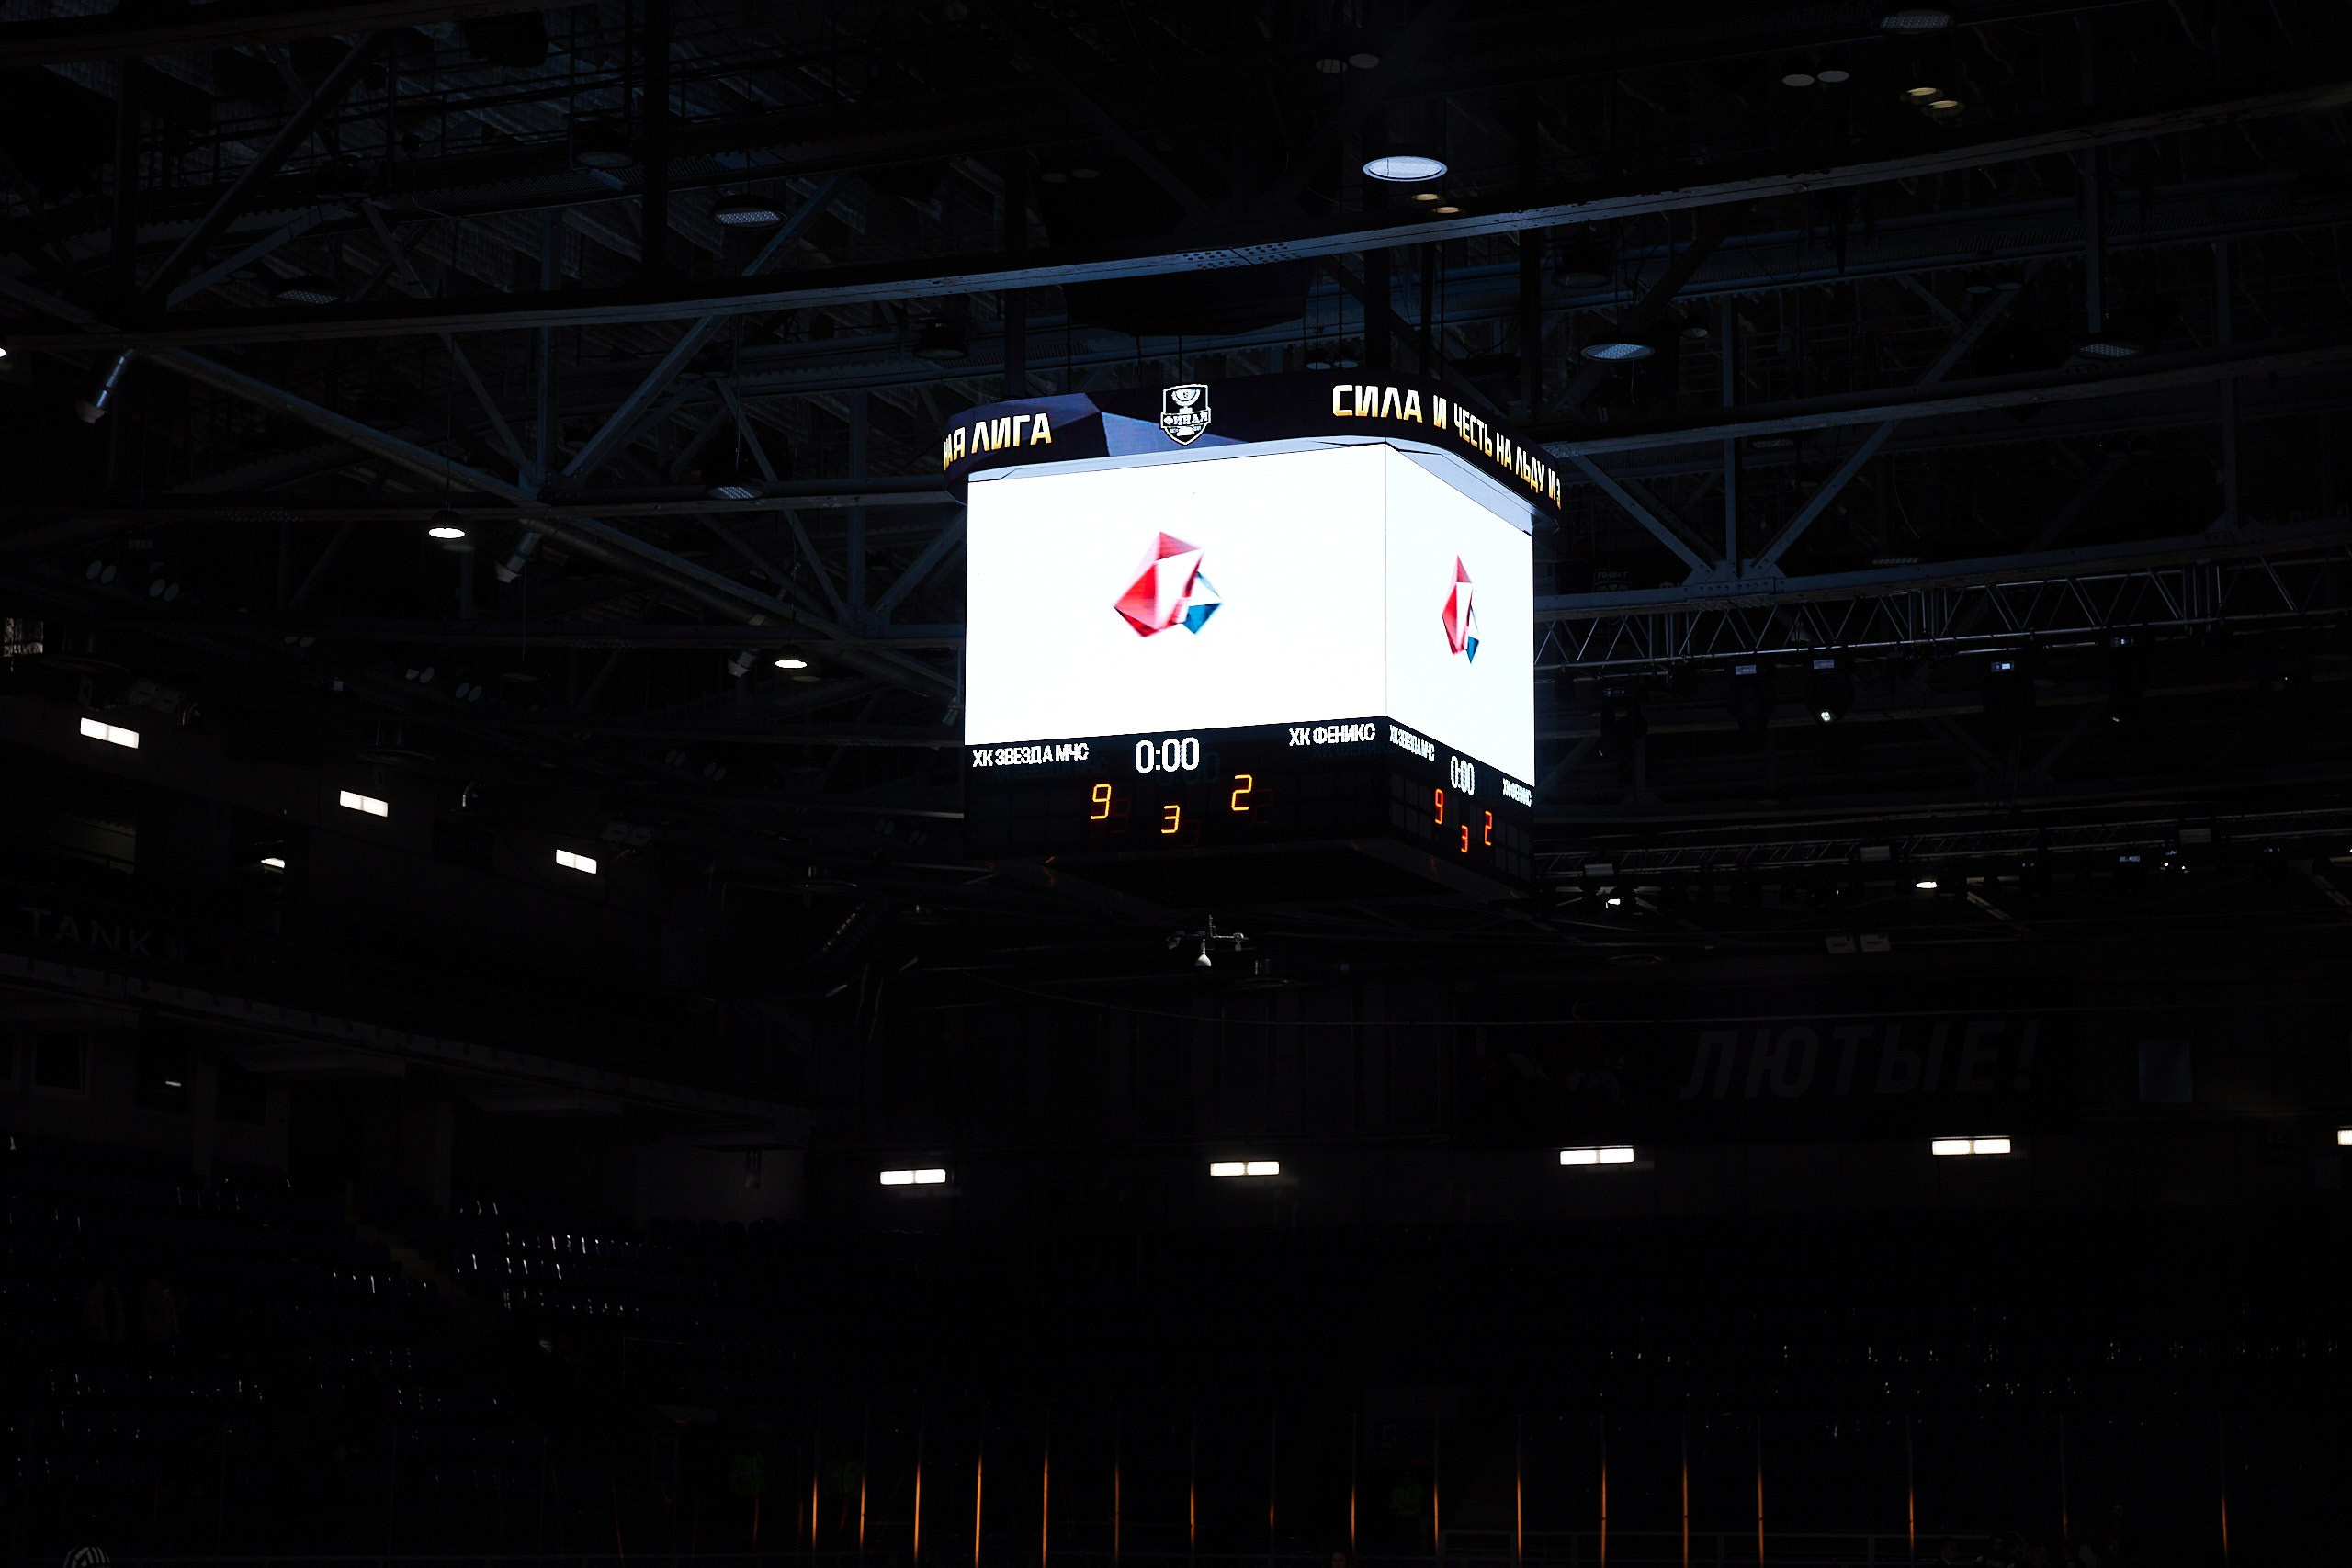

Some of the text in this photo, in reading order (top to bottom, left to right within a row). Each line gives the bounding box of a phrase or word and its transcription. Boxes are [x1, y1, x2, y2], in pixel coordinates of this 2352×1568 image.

[971, 412, 1052, 454] ЛИГА
[1163, 411, 1208, 426] ФИНАЛ
[1332, 384, 1424, 423] СИЛА
[1432, 394, 1448, 431] И
[1453, 402, 1493, 458] ЧЕСТЬ
[1496, 432, 1513, 471] НА
[1515, 446, 1545, 494] ЛЬДУ
[1288, 722, 1376, 747] ХК ФЕНИКС
[972, 742, 1090, 768] ХК ЗВЕЗДА МЧС
[1135, 736, 1201, 774] 0:00
[1229, 773, 1254, 812] 2
[1450, 755, 1476, 796] 0:00
[1090, 783, 1113, 820] 9
[1160, 804, 1182, 834] 3
[1434, 788, 1444, 825] 9
[1460, 825, 1469, 853] 3
[1484, 810, 1493, 846] 2
[18, 903, 153, 958] TANK
[1678, 1018, 2041, 1101] ЛЮТЫЕ!
